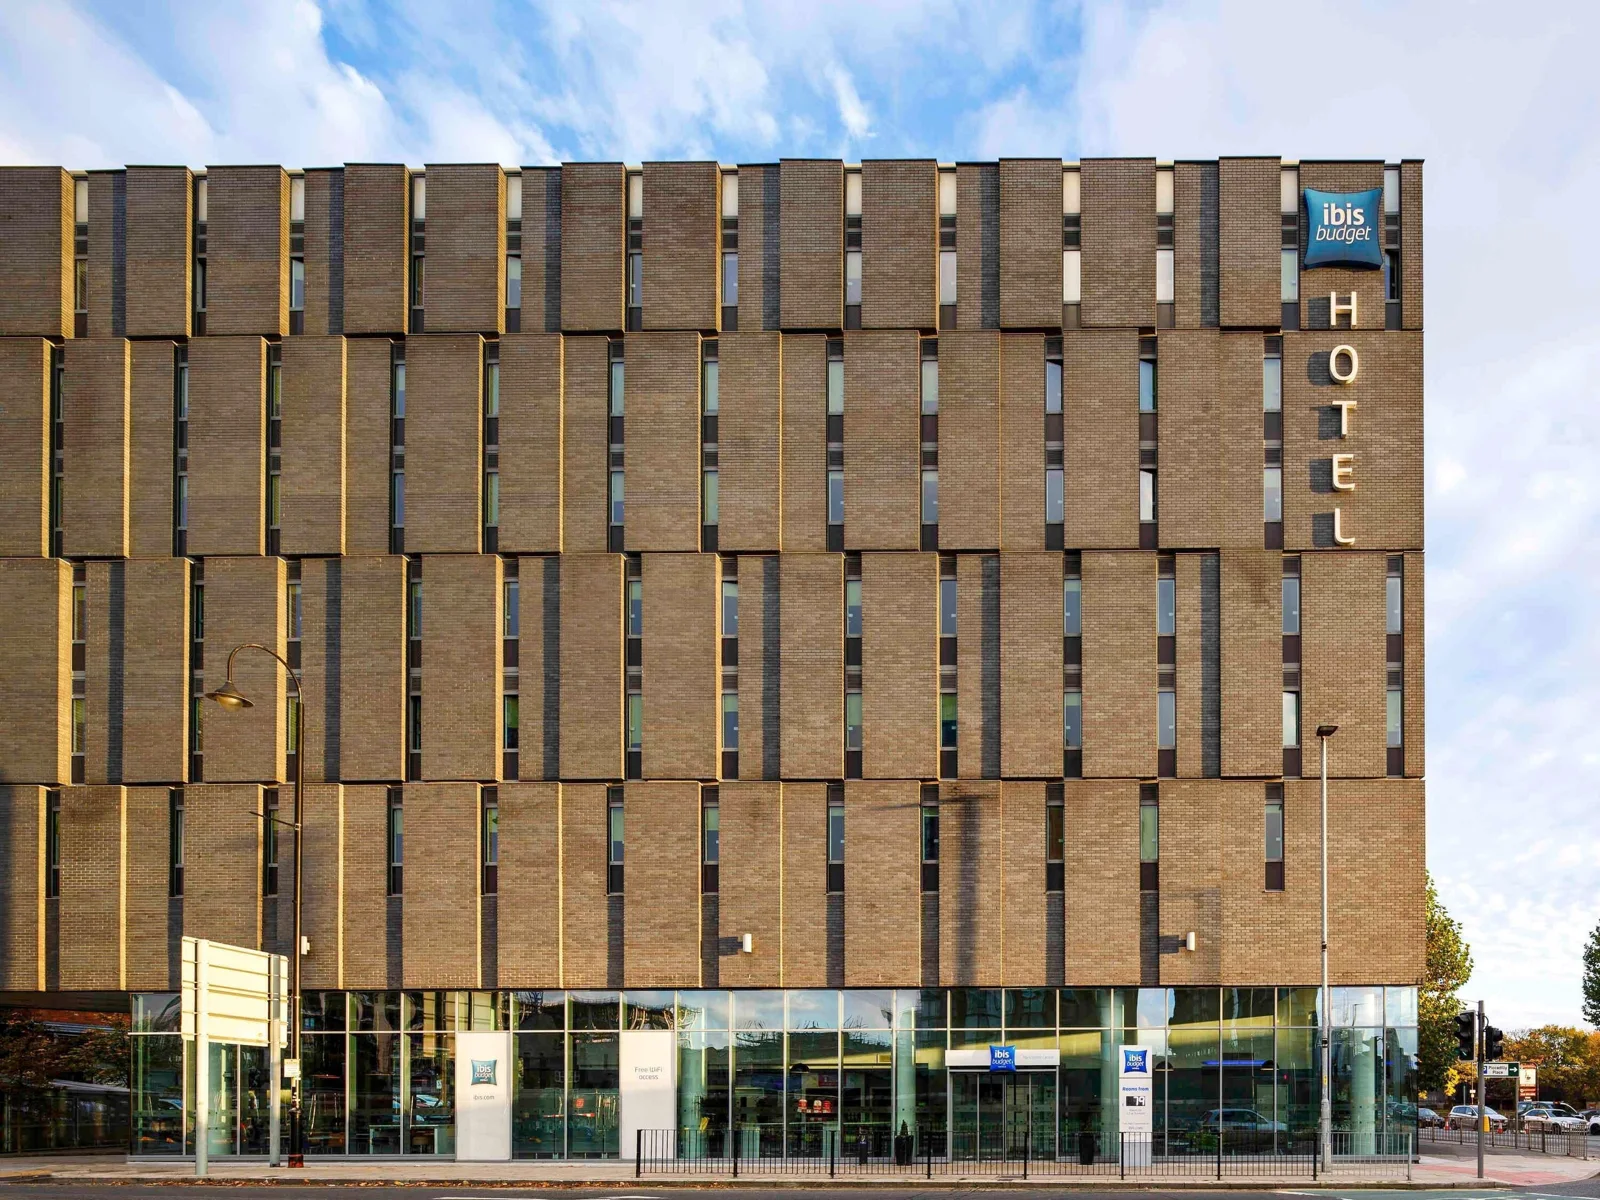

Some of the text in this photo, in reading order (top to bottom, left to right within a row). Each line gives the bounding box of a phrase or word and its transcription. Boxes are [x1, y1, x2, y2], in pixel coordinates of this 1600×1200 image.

[1323, 203, 1364, 225] ibis
[1316, 225, 1371, 244] budget
[1329, 291, 1358, 546] HOTEL
[995, 1050, 1010, 1058] ibis
[1129, 1054, 1142, 1062] ibis
